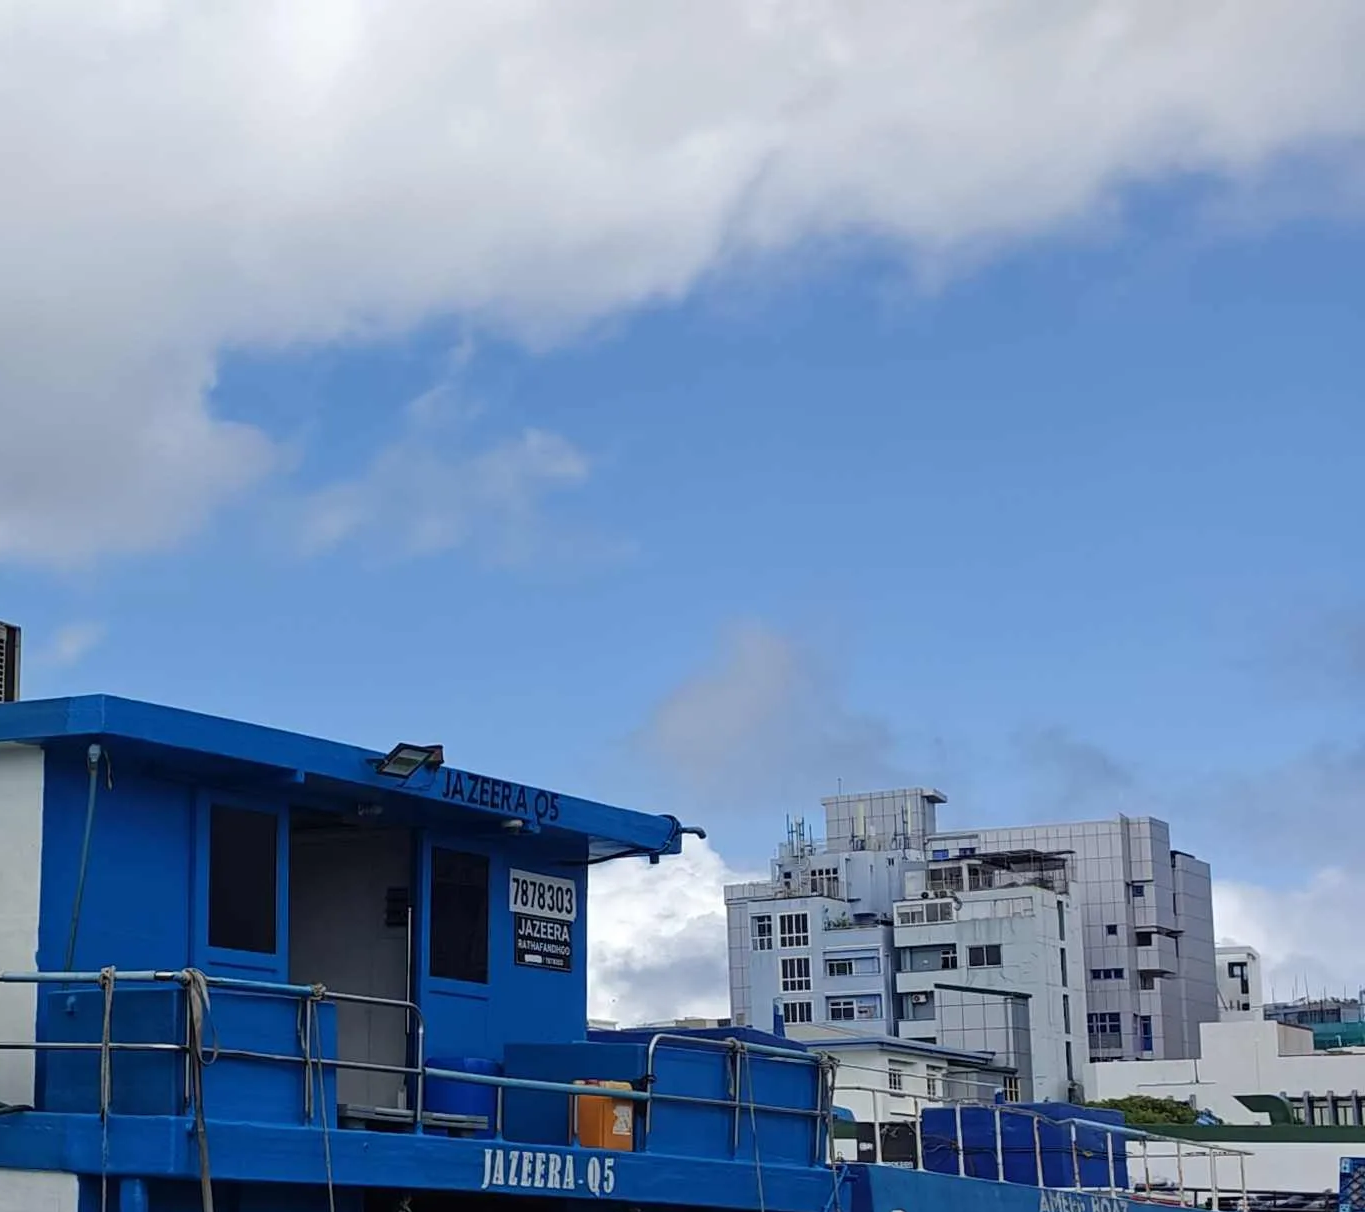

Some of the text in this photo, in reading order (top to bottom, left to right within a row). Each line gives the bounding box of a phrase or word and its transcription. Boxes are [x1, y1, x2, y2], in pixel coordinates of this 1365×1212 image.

[441, 771, 529, 814] JAZEERA
[512, 877, 573, 914] 7878303
[518, 918, 570, 941] JAZEERA
